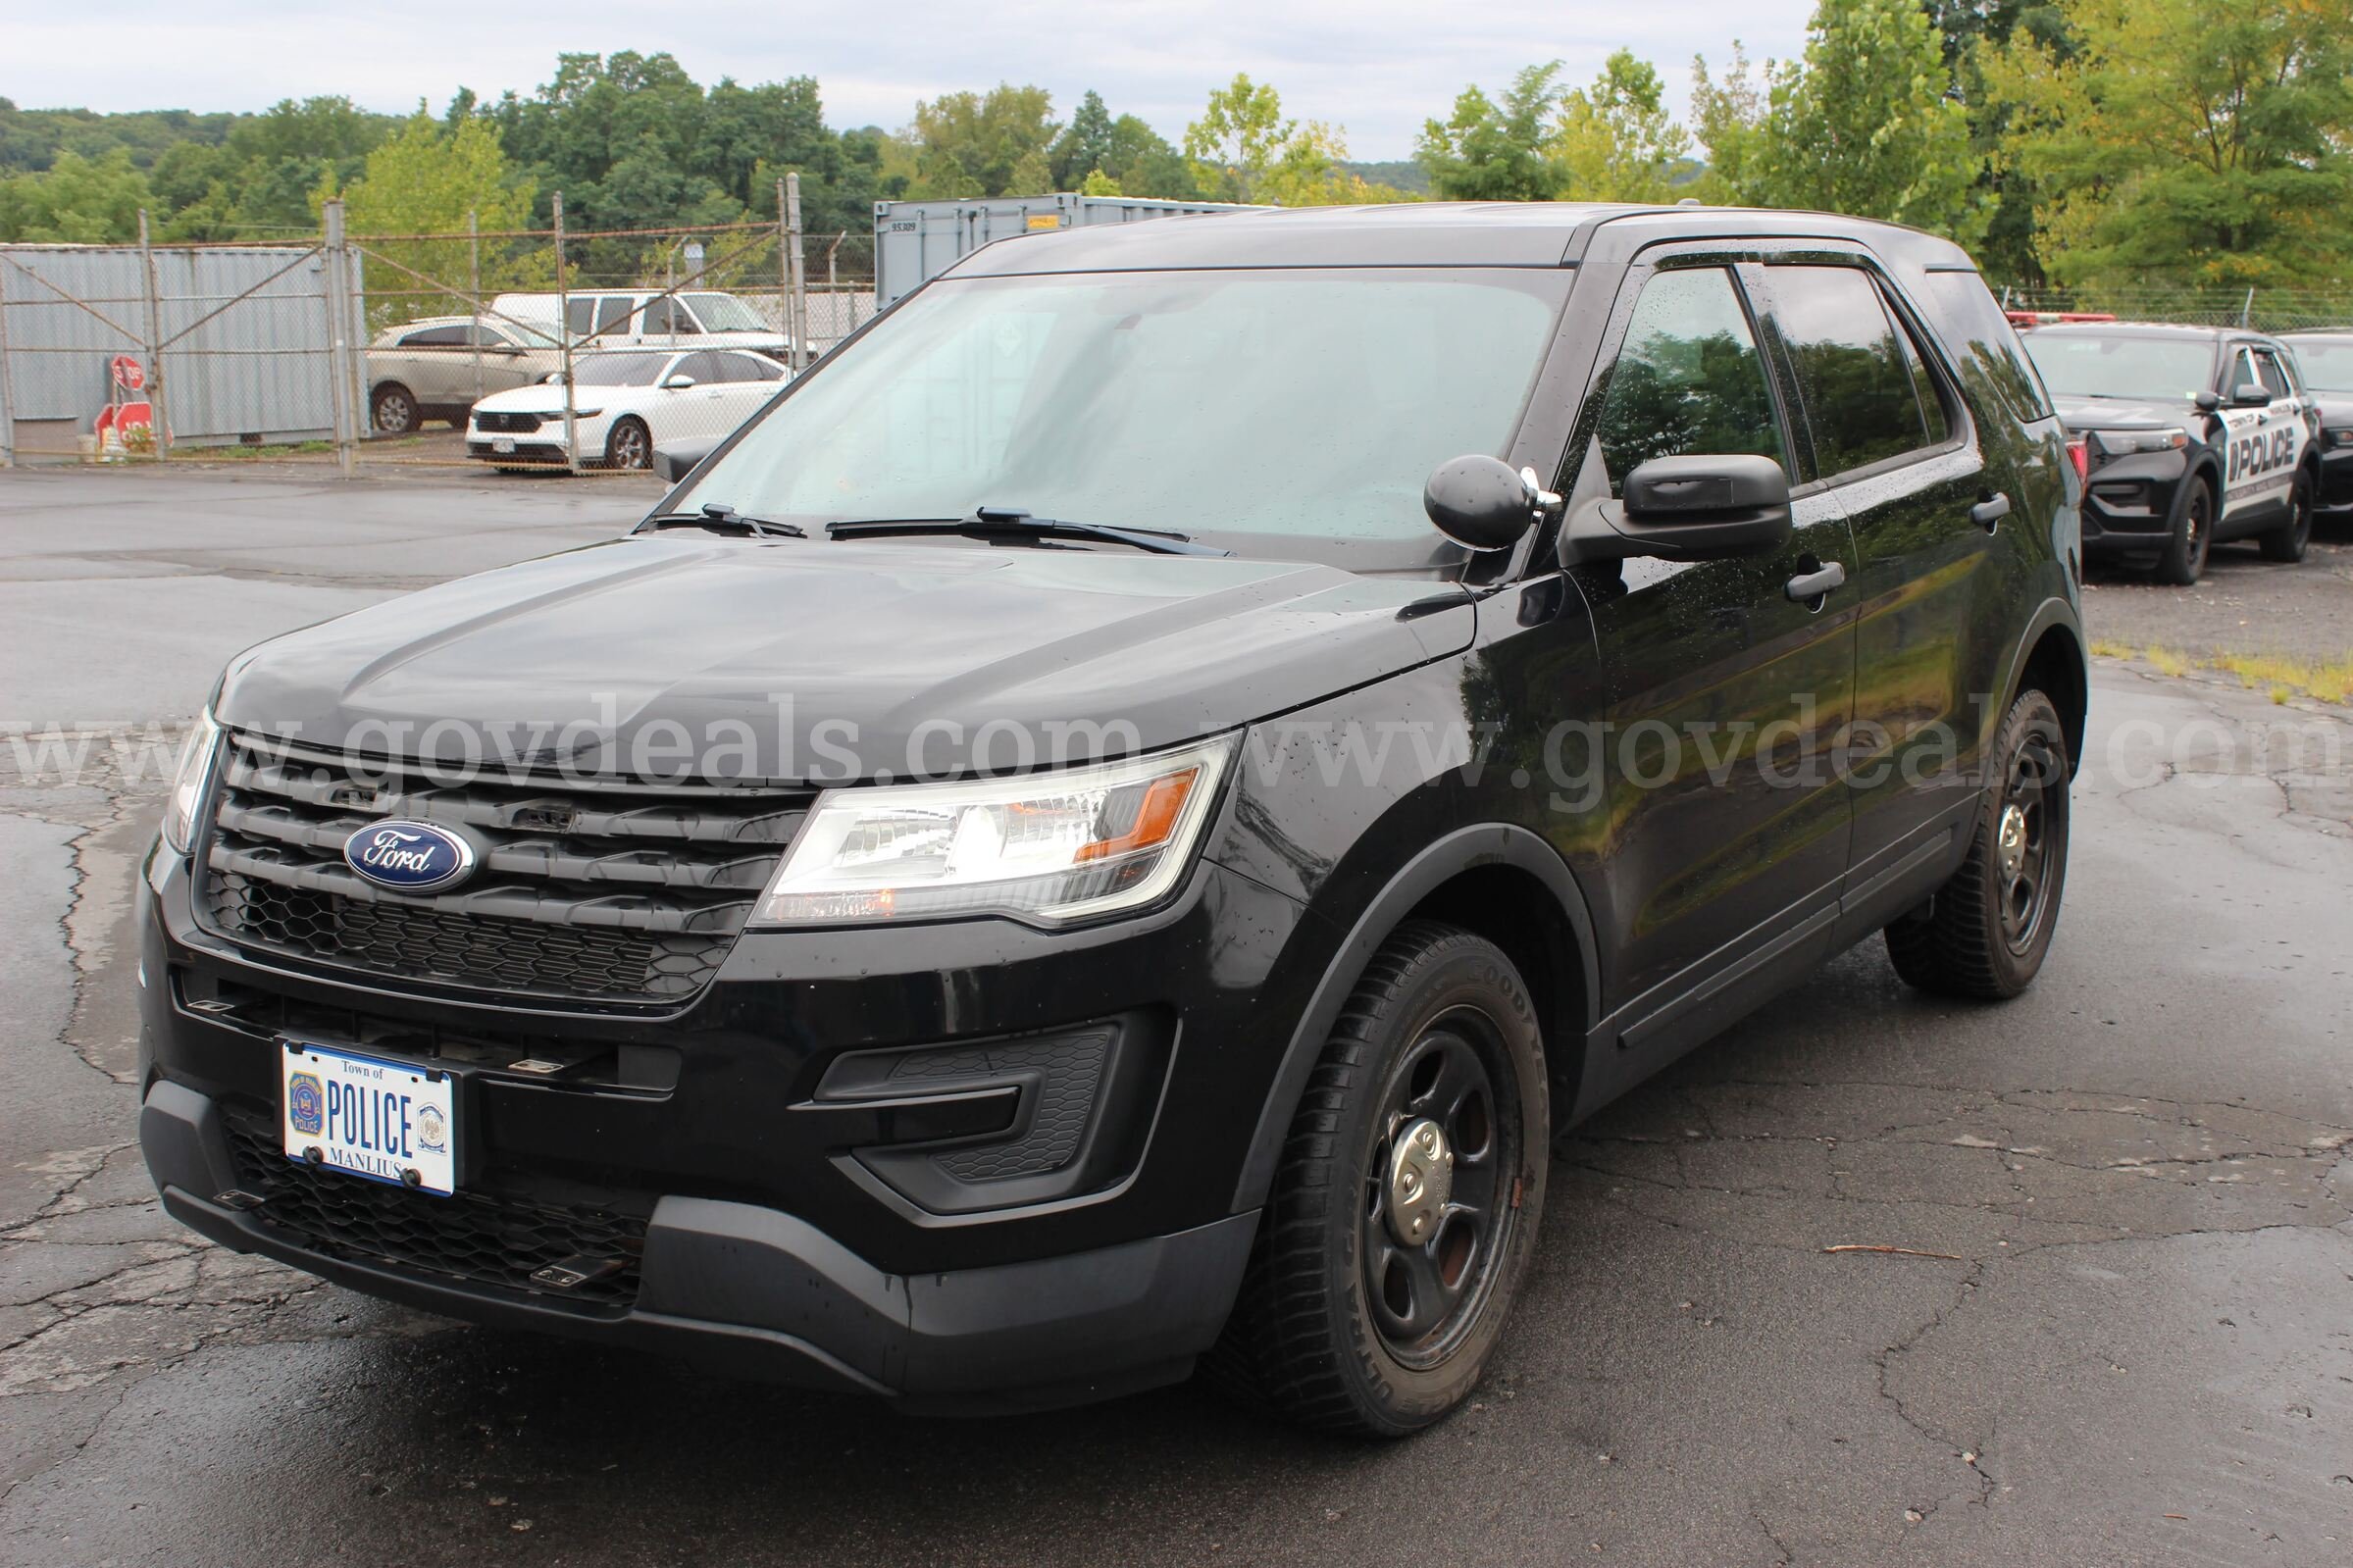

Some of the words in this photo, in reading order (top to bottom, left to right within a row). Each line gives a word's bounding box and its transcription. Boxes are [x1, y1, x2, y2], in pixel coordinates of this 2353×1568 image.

[113, 365, 141, 380] SOP
[2237, 427, 2293, 480] POLICE
[364, 830, 435, 872] Ford
[341, 1060, 370, 1077] Town
[373, 1068, 384, 1080] of
[327, 1080, 413, 1159] POLICE
[330, 1146, 402, 1179] MANLIUS
